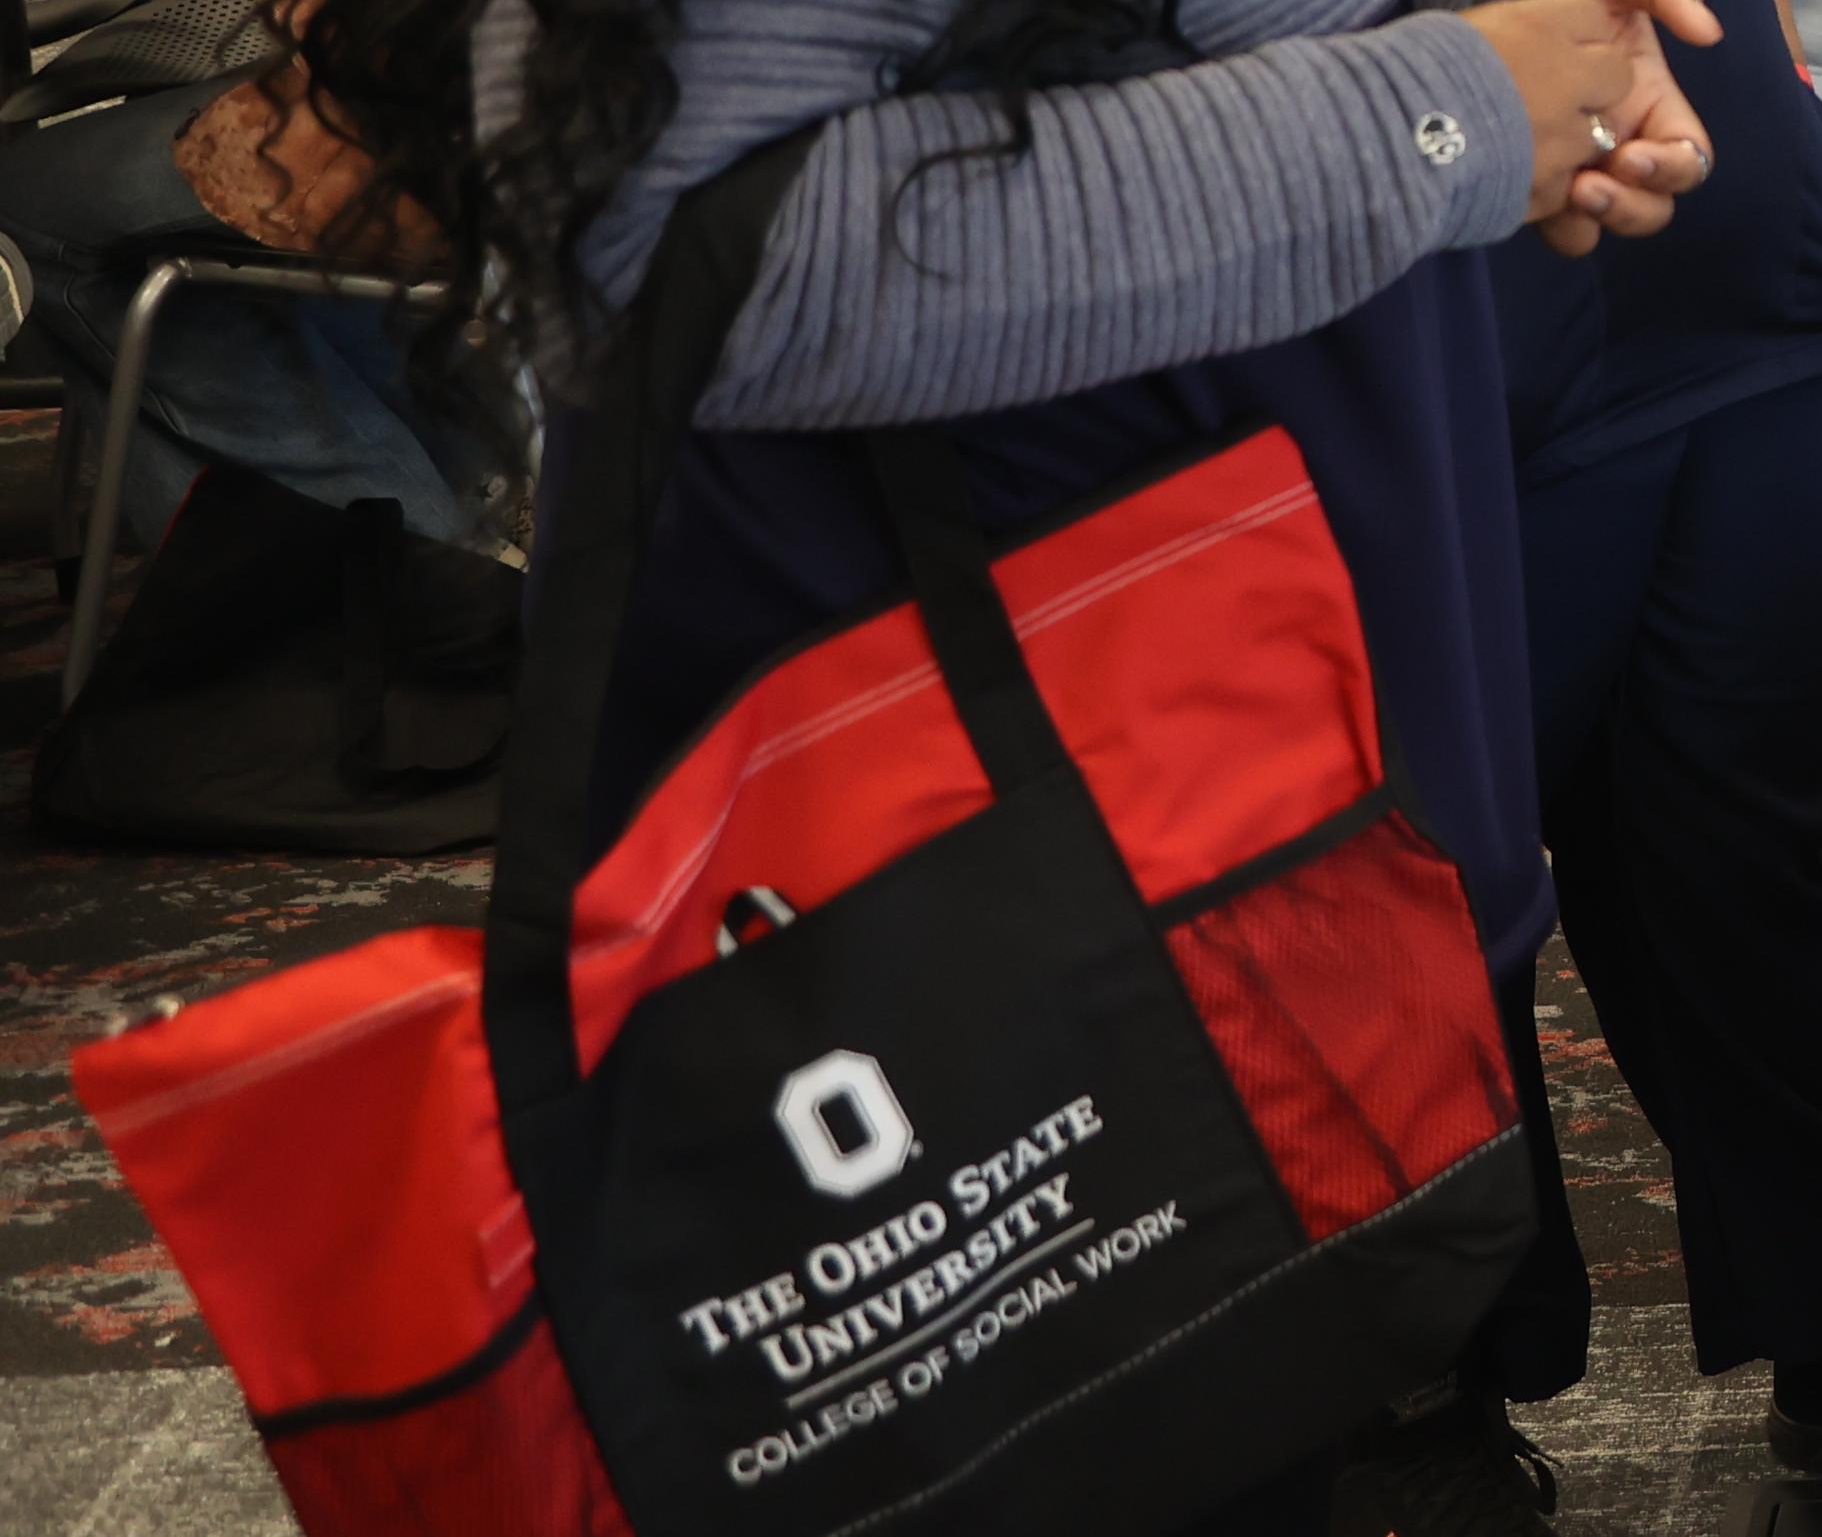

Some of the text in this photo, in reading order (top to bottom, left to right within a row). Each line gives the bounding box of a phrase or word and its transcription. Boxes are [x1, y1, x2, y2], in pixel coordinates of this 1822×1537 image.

[680, 1093, 1104, 1357] THE OHIO STATE
[726, 1198, 1189, 1488] COLLEGE OF SOCIAL WORK
[758, 1171, 1075, 1384] UNIVERSITY
